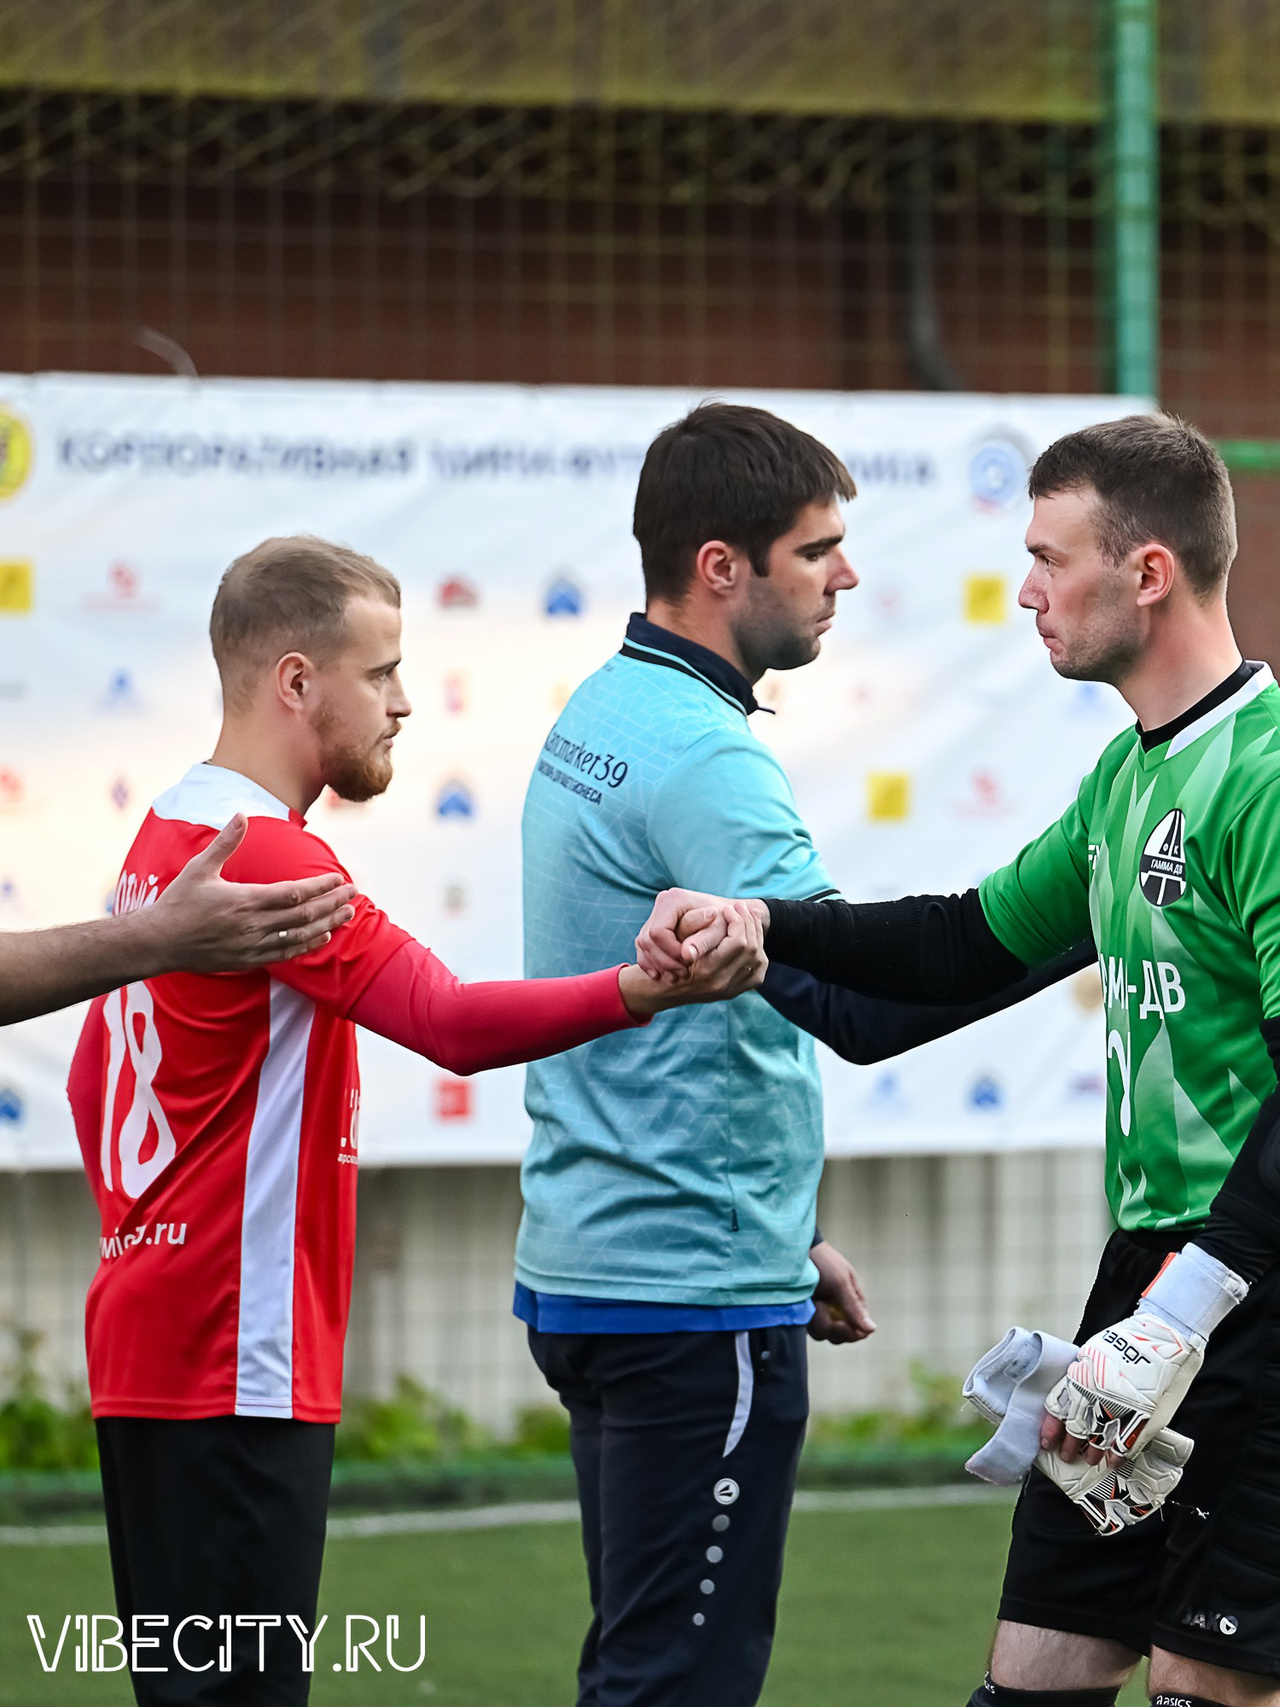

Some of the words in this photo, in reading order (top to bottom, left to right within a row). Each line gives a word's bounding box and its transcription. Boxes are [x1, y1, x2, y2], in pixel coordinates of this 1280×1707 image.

[1150, 858, 1174, 873] ГАММА
[1173, 863, 1183, 876] ДВ
[101, 980, 177, 1199] 18
